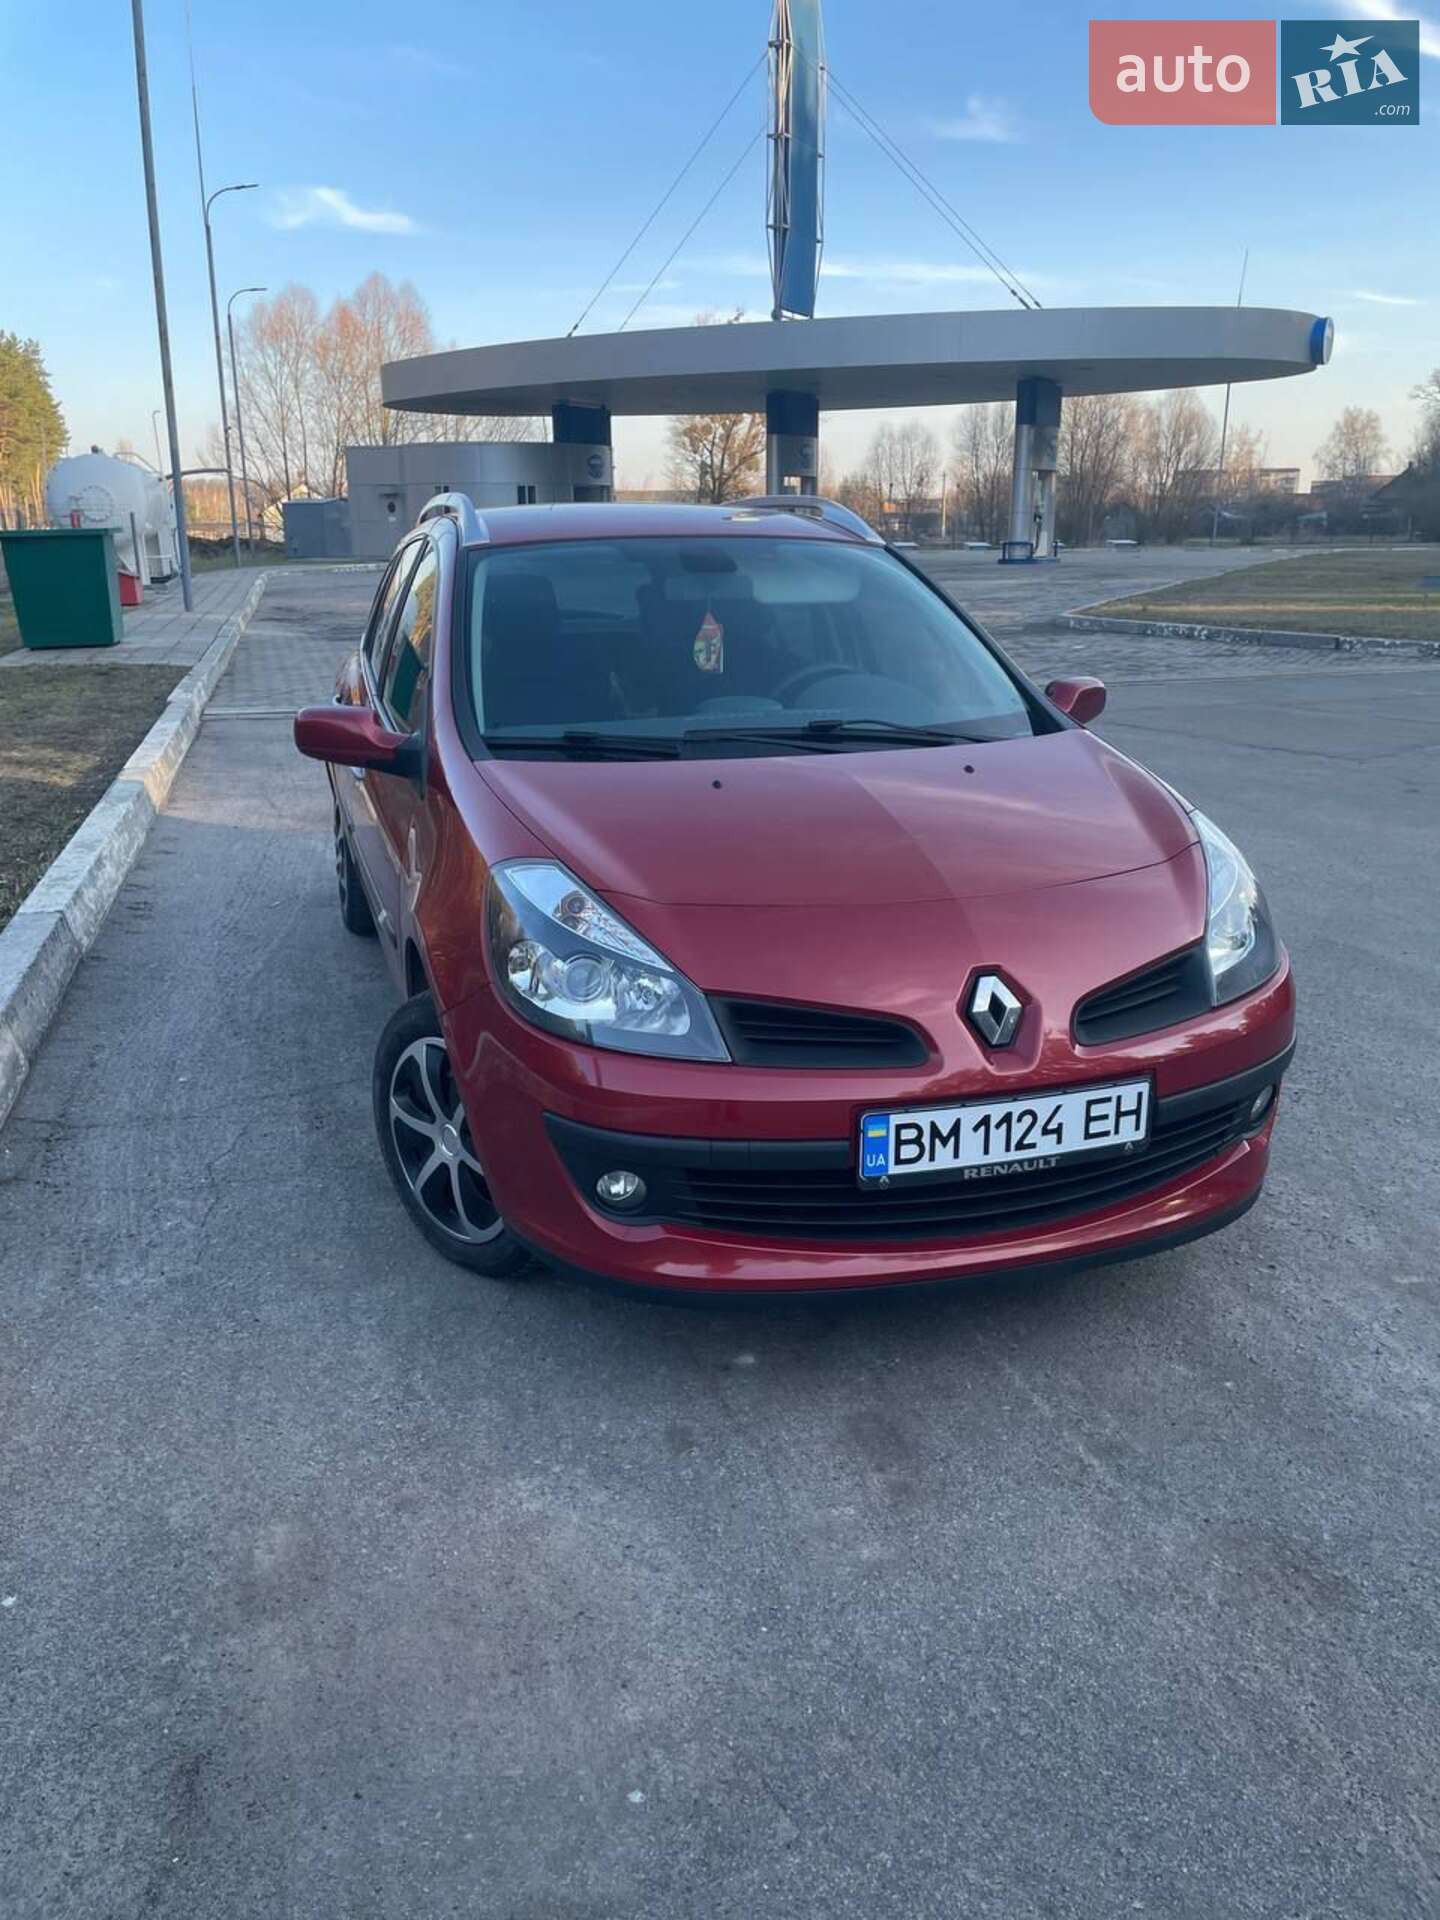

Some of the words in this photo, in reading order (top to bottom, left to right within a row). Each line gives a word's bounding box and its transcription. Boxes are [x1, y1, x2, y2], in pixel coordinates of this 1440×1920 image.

[894, 1117, 961, 1166] BM
[972, 1104, 1063, 1155] 1124
[1084, 1091, 1143, 1140] EH
[867, 1153, 886, 1167] UA
[964, 1156, 1060, 1180] RENAULT
